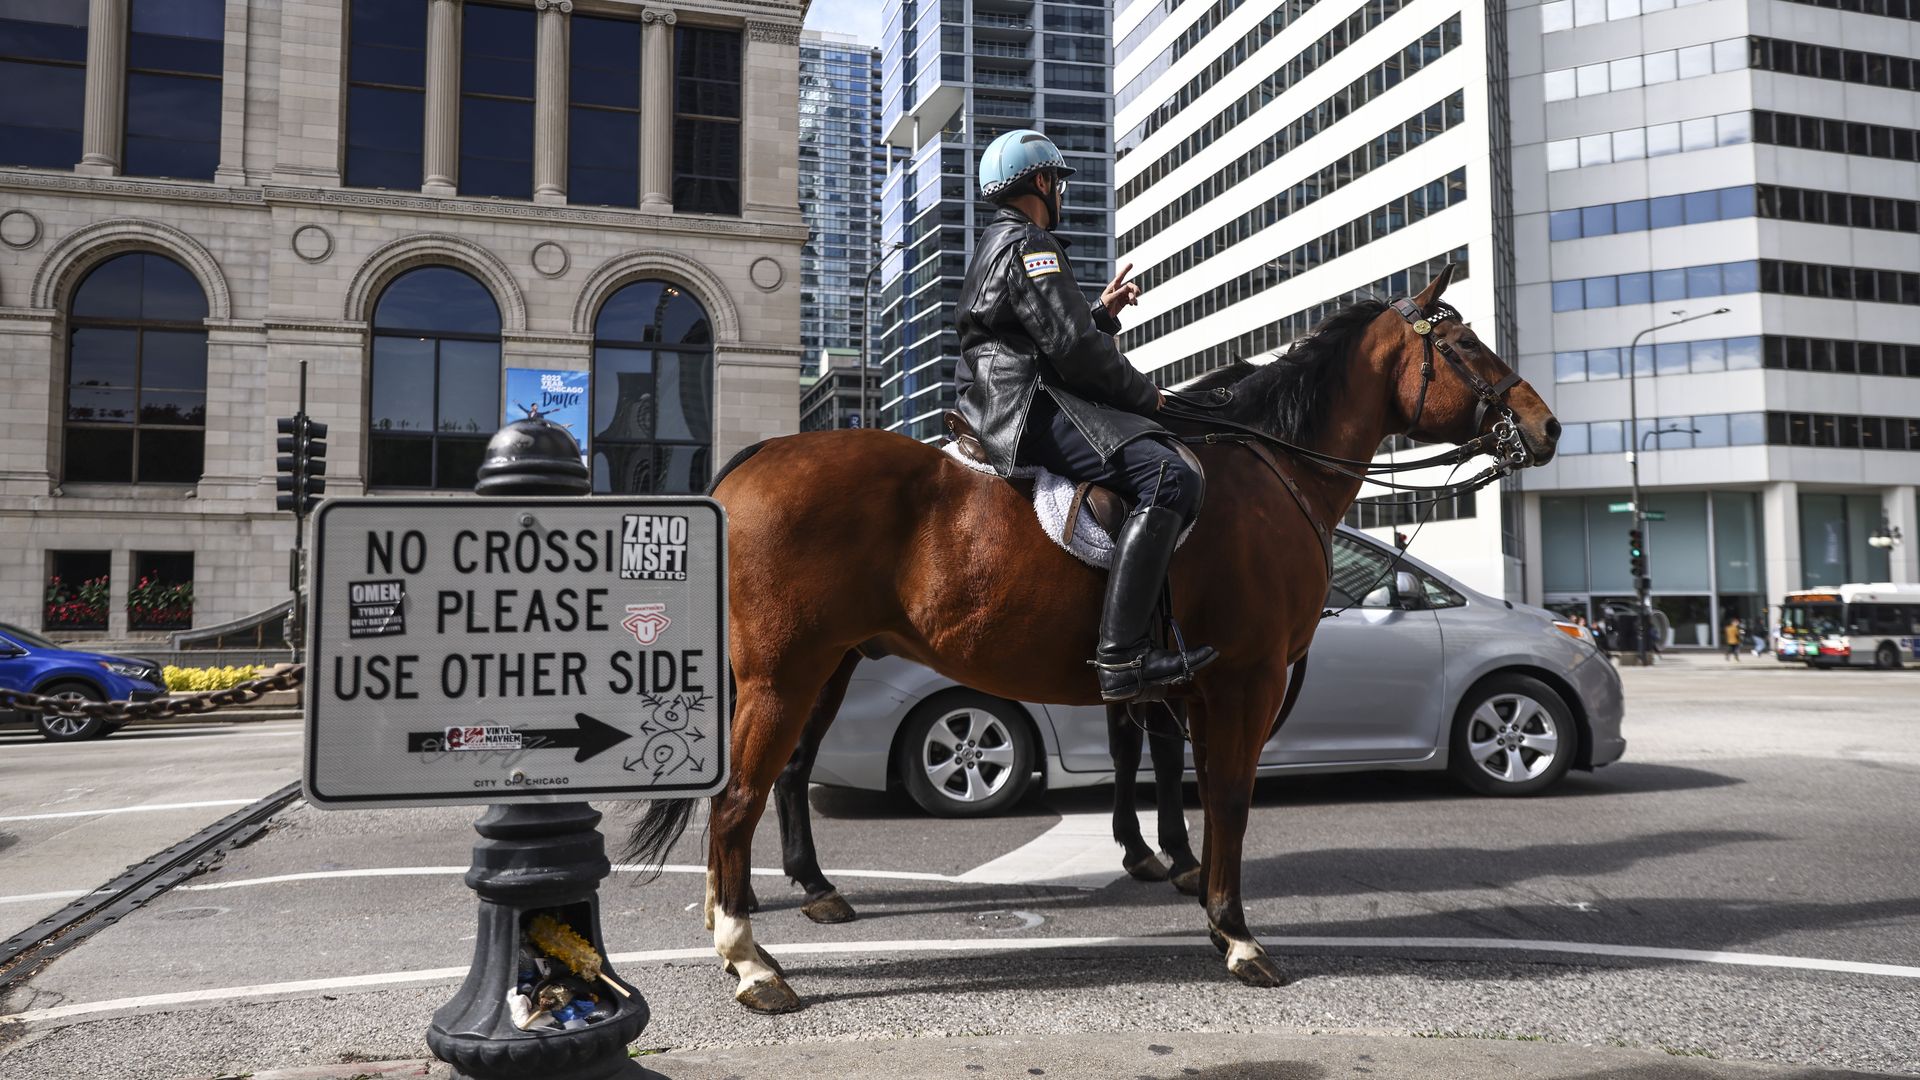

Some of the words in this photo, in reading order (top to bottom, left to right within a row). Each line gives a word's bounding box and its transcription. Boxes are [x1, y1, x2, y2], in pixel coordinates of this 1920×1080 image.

[547, 385, 584, 394] CHICAGO
[623, 515, 687, 545] ZENO
[366, 530, 428, 574] NO
[453, 529, 614, 574] CROSSI
[622, 543, 687, 572] MSFT
[621, 570, 651, 579] KYT
[654, 571, 687, 580] DTC
[353, 583, 400, 603] OMEN
[437, 588, 609, 634] PLEASE
[334, 654, 420, 701] USE
[441, 651, 588, 699] OTHER
[608, 649, 704, 695] SIDE
[485, 727, 510, 735] VINYL
[485, 735, 521, 743] MAYHEM
[473, 779, 497, 788] CITY
[525, 776, 570, 785] CHICAGO
